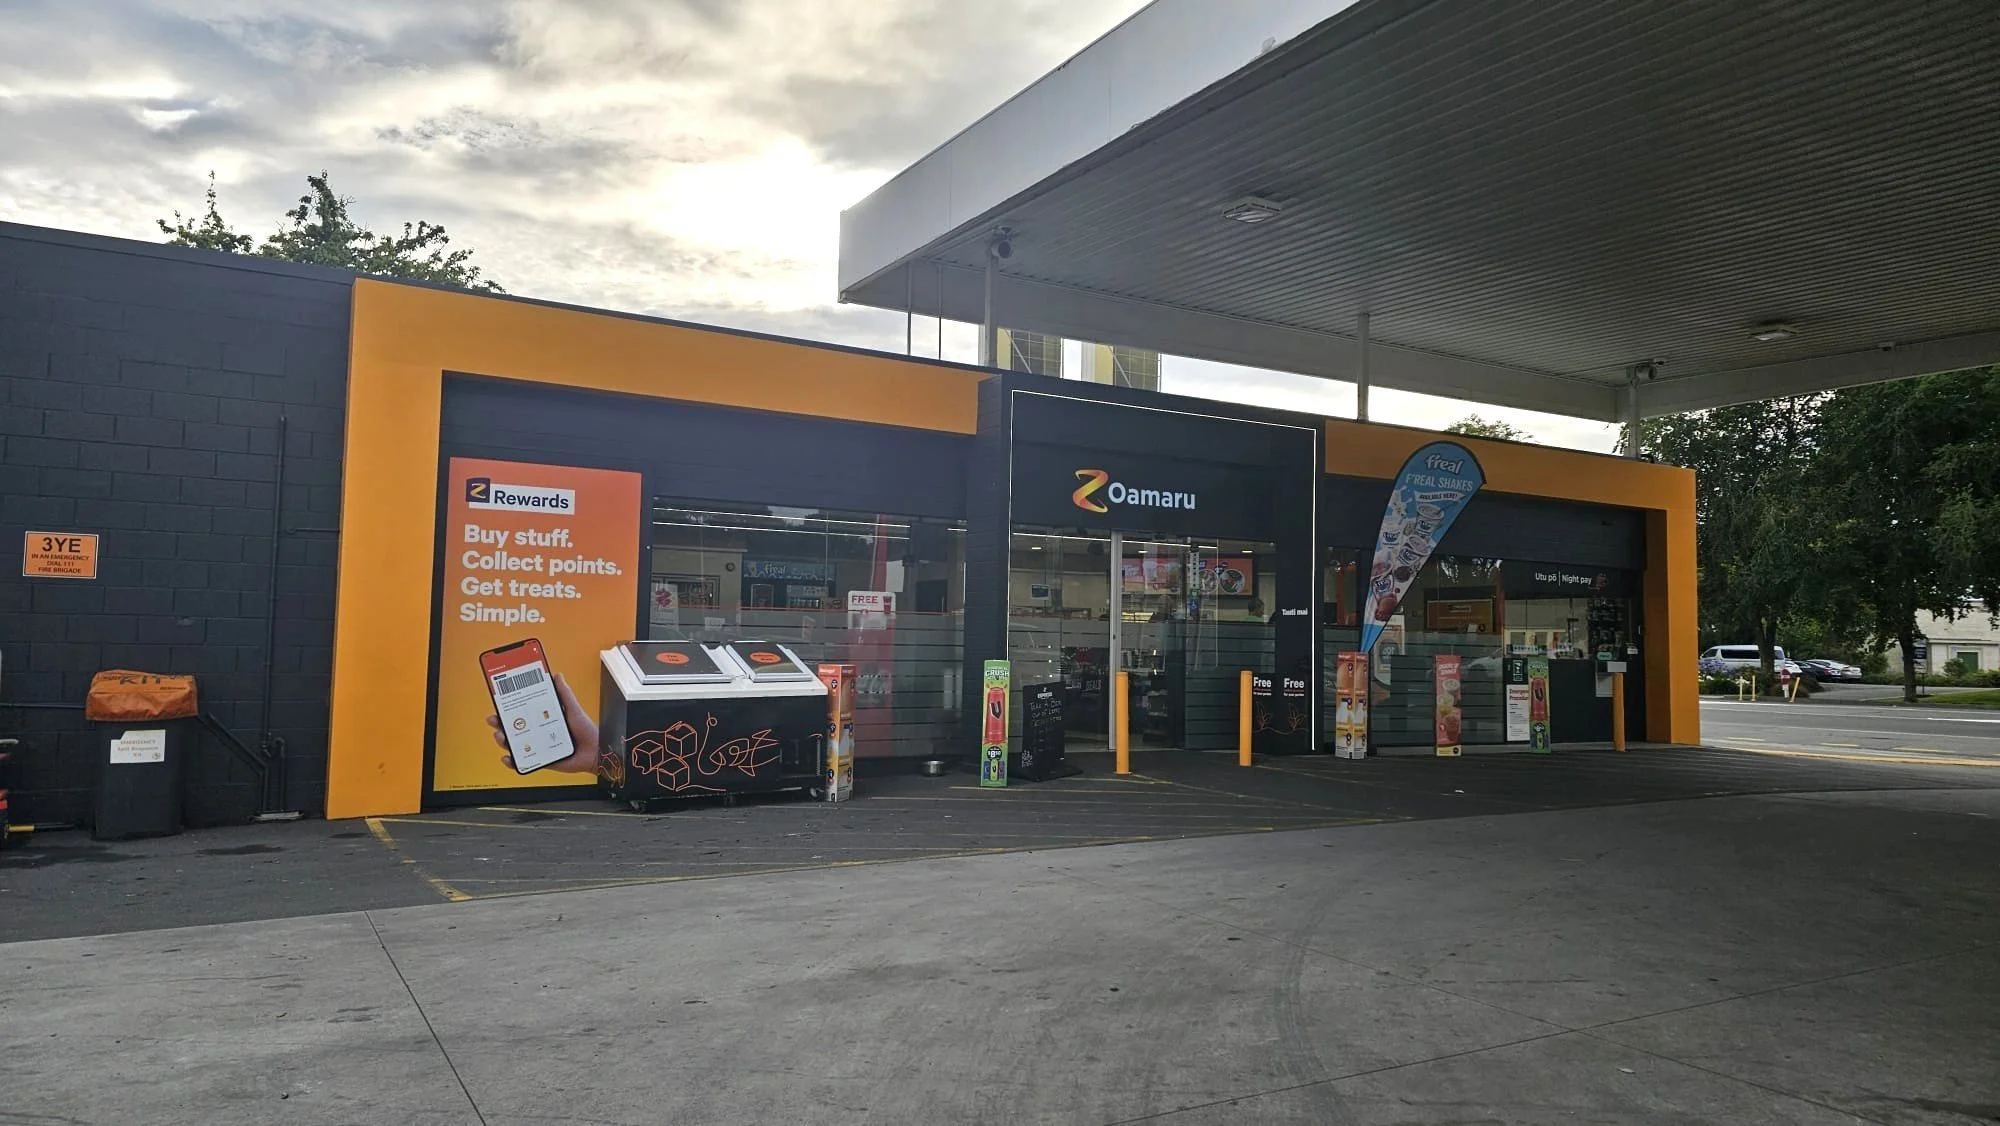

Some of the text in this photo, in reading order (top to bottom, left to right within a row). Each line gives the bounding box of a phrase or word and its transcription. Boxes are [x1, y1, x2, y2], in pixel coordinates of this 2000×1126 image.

[1424, 454, 1464, 475] f'real
[1405, 473, 1474, 492] F'REAL SHAKES
[494, 490, 569, 509] Rewards
[1108, 482, 1196, 510] Oamaru
[42, 536, 82, 553] 3YE
[464, 524, 574, 548] Buy stuff.
[462, 550, 622, 576] Collect points.
[460, 576, 582, 599] Get treats.
[1535, 572, 1547, 581] Utu
[1562, 574, 1579, 584] Night
[1580, 577, 1592, 585] pay
[852, 595, 879, 604] FREE
[459, 602, 546, 627] Simple.
[985, 669, 1009, 677] CRUSH
[1253, 677, 1272, 688] Free
[1283, 677, 1305, 688] Free
